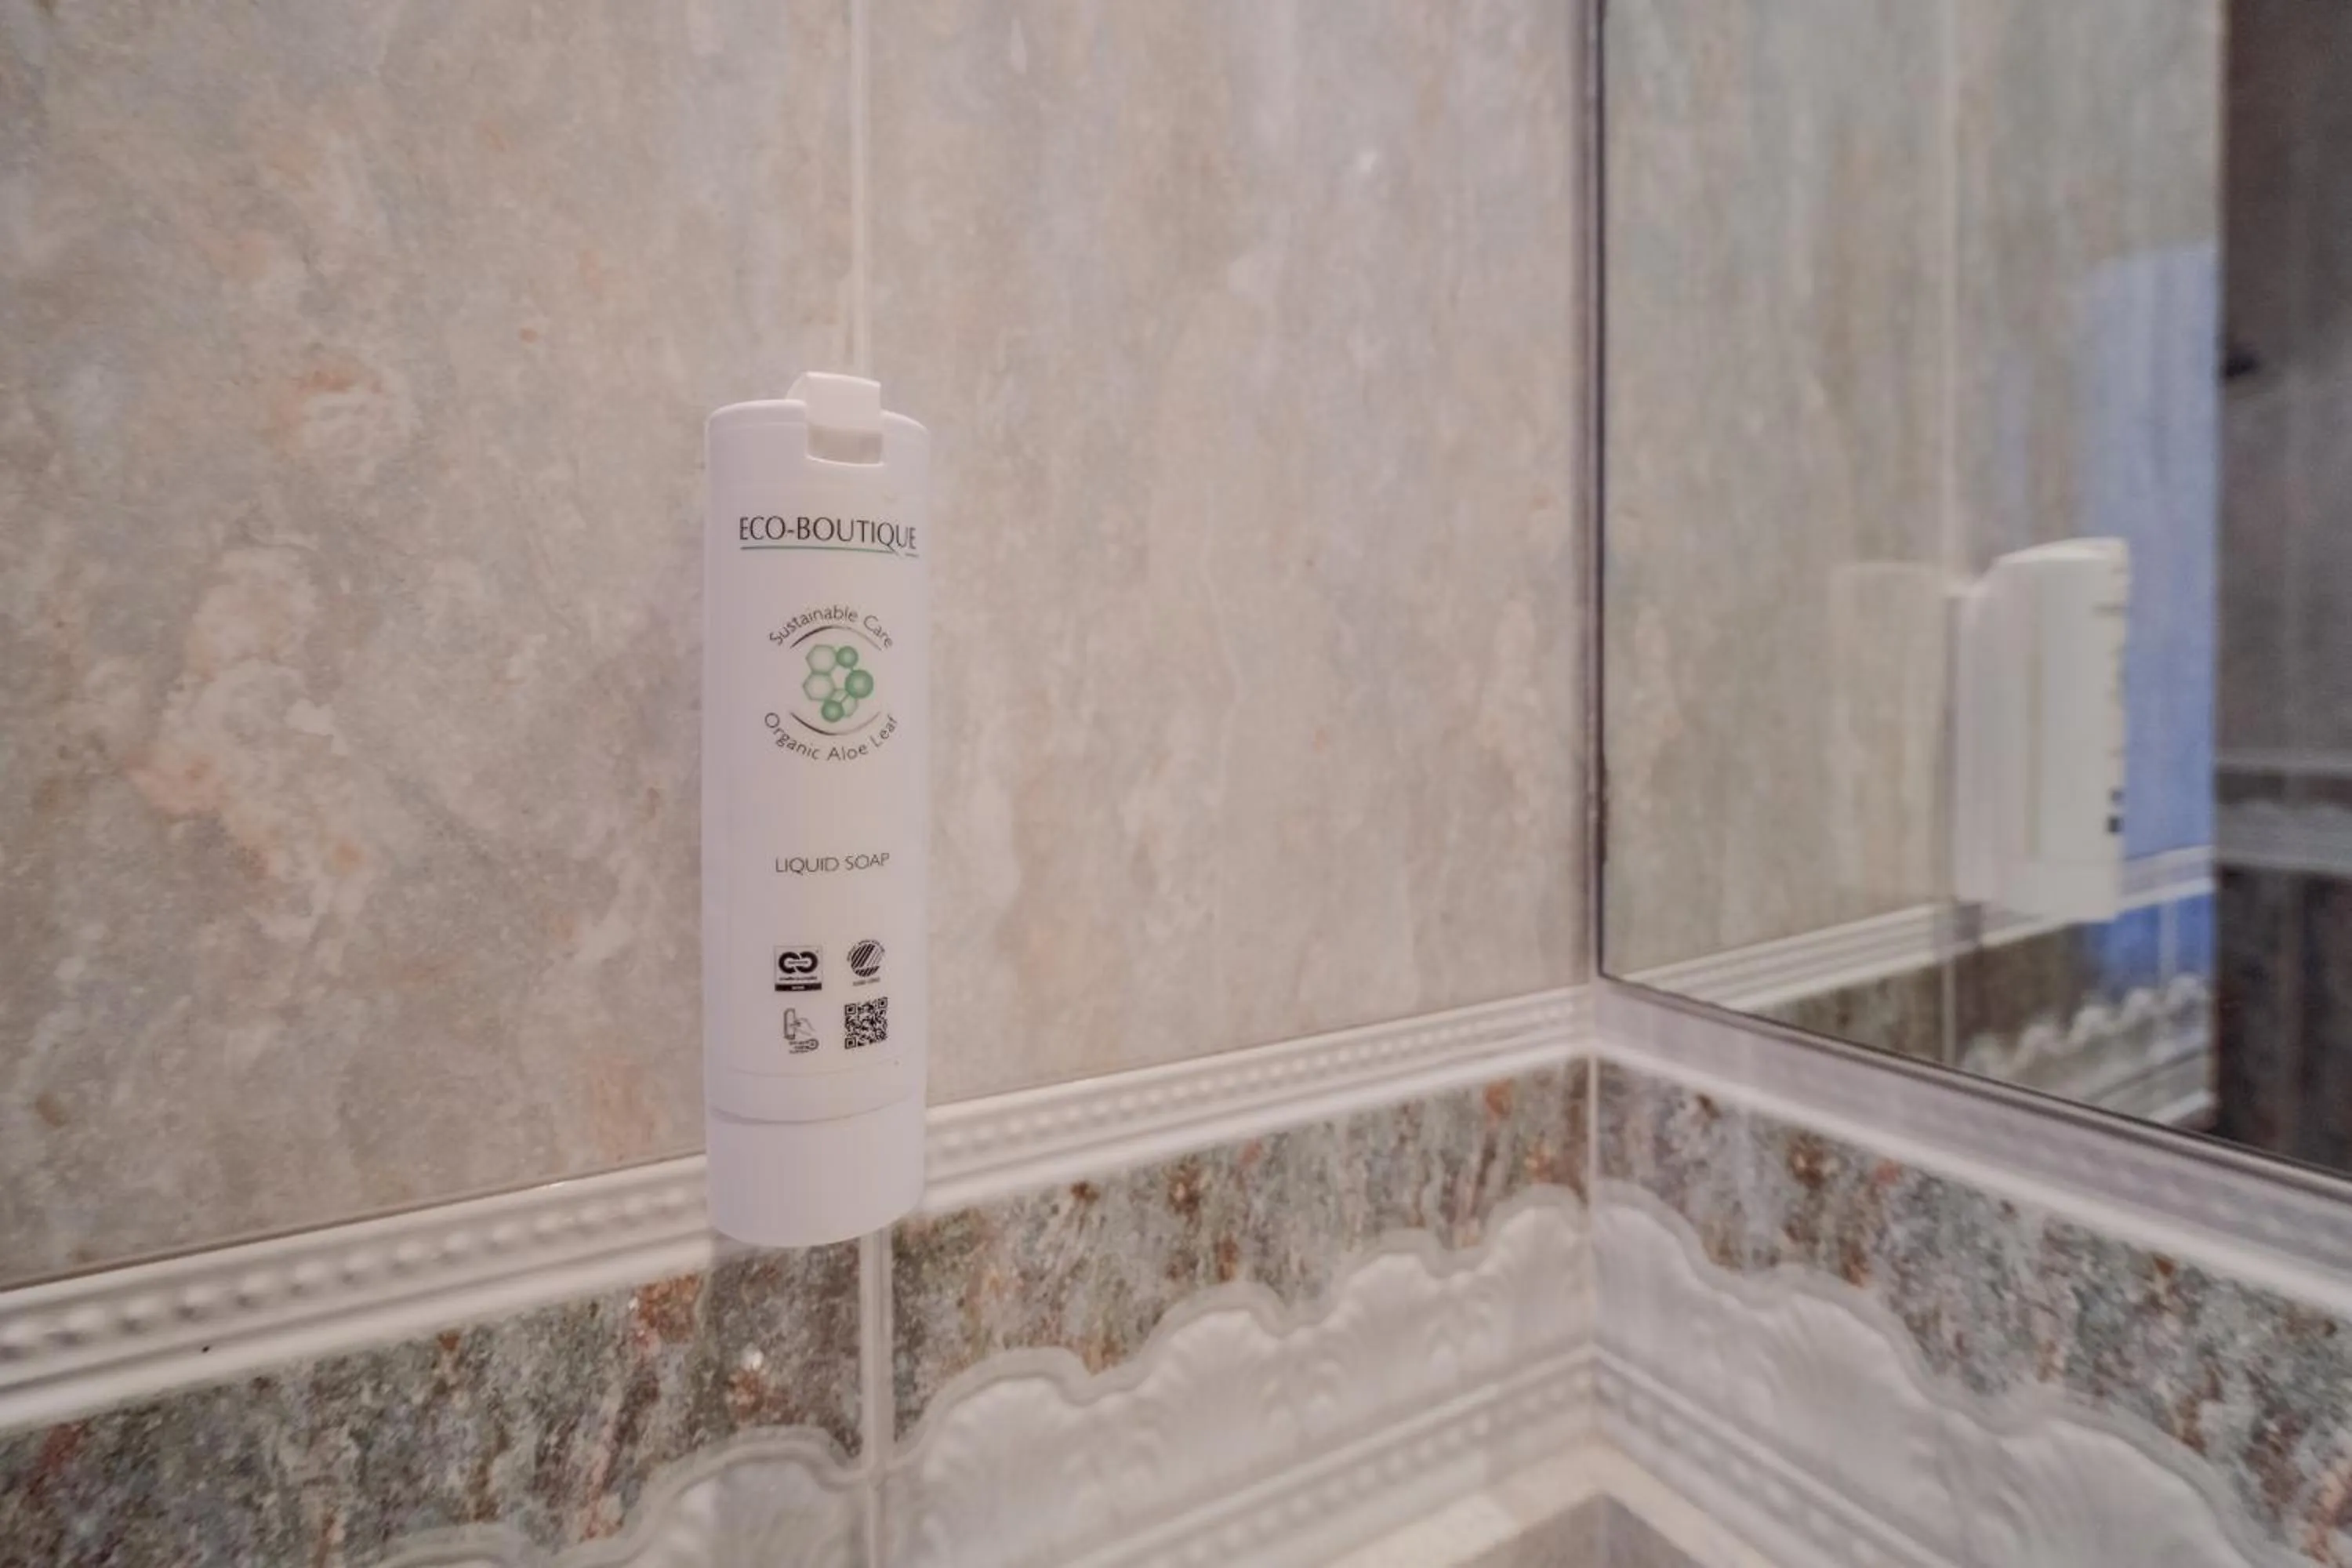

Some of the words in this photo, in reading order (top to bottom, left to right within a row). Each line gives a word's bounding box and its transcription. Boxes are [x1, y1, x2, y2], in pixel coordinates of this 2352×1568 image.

[739, 515, 916, 554] ECO-BOUTIQUE
[769, 605, 858, 646] Sustainable
[863, 615, 893, 648] Care
[764, 712, 822, 760] Organic
[827, 745, 869, 760] Aloe
[869, 713, 897, 748] Leaf
[775, 857, 840, 876] LIQUID
[844, 852, 889, 870] SOAP
